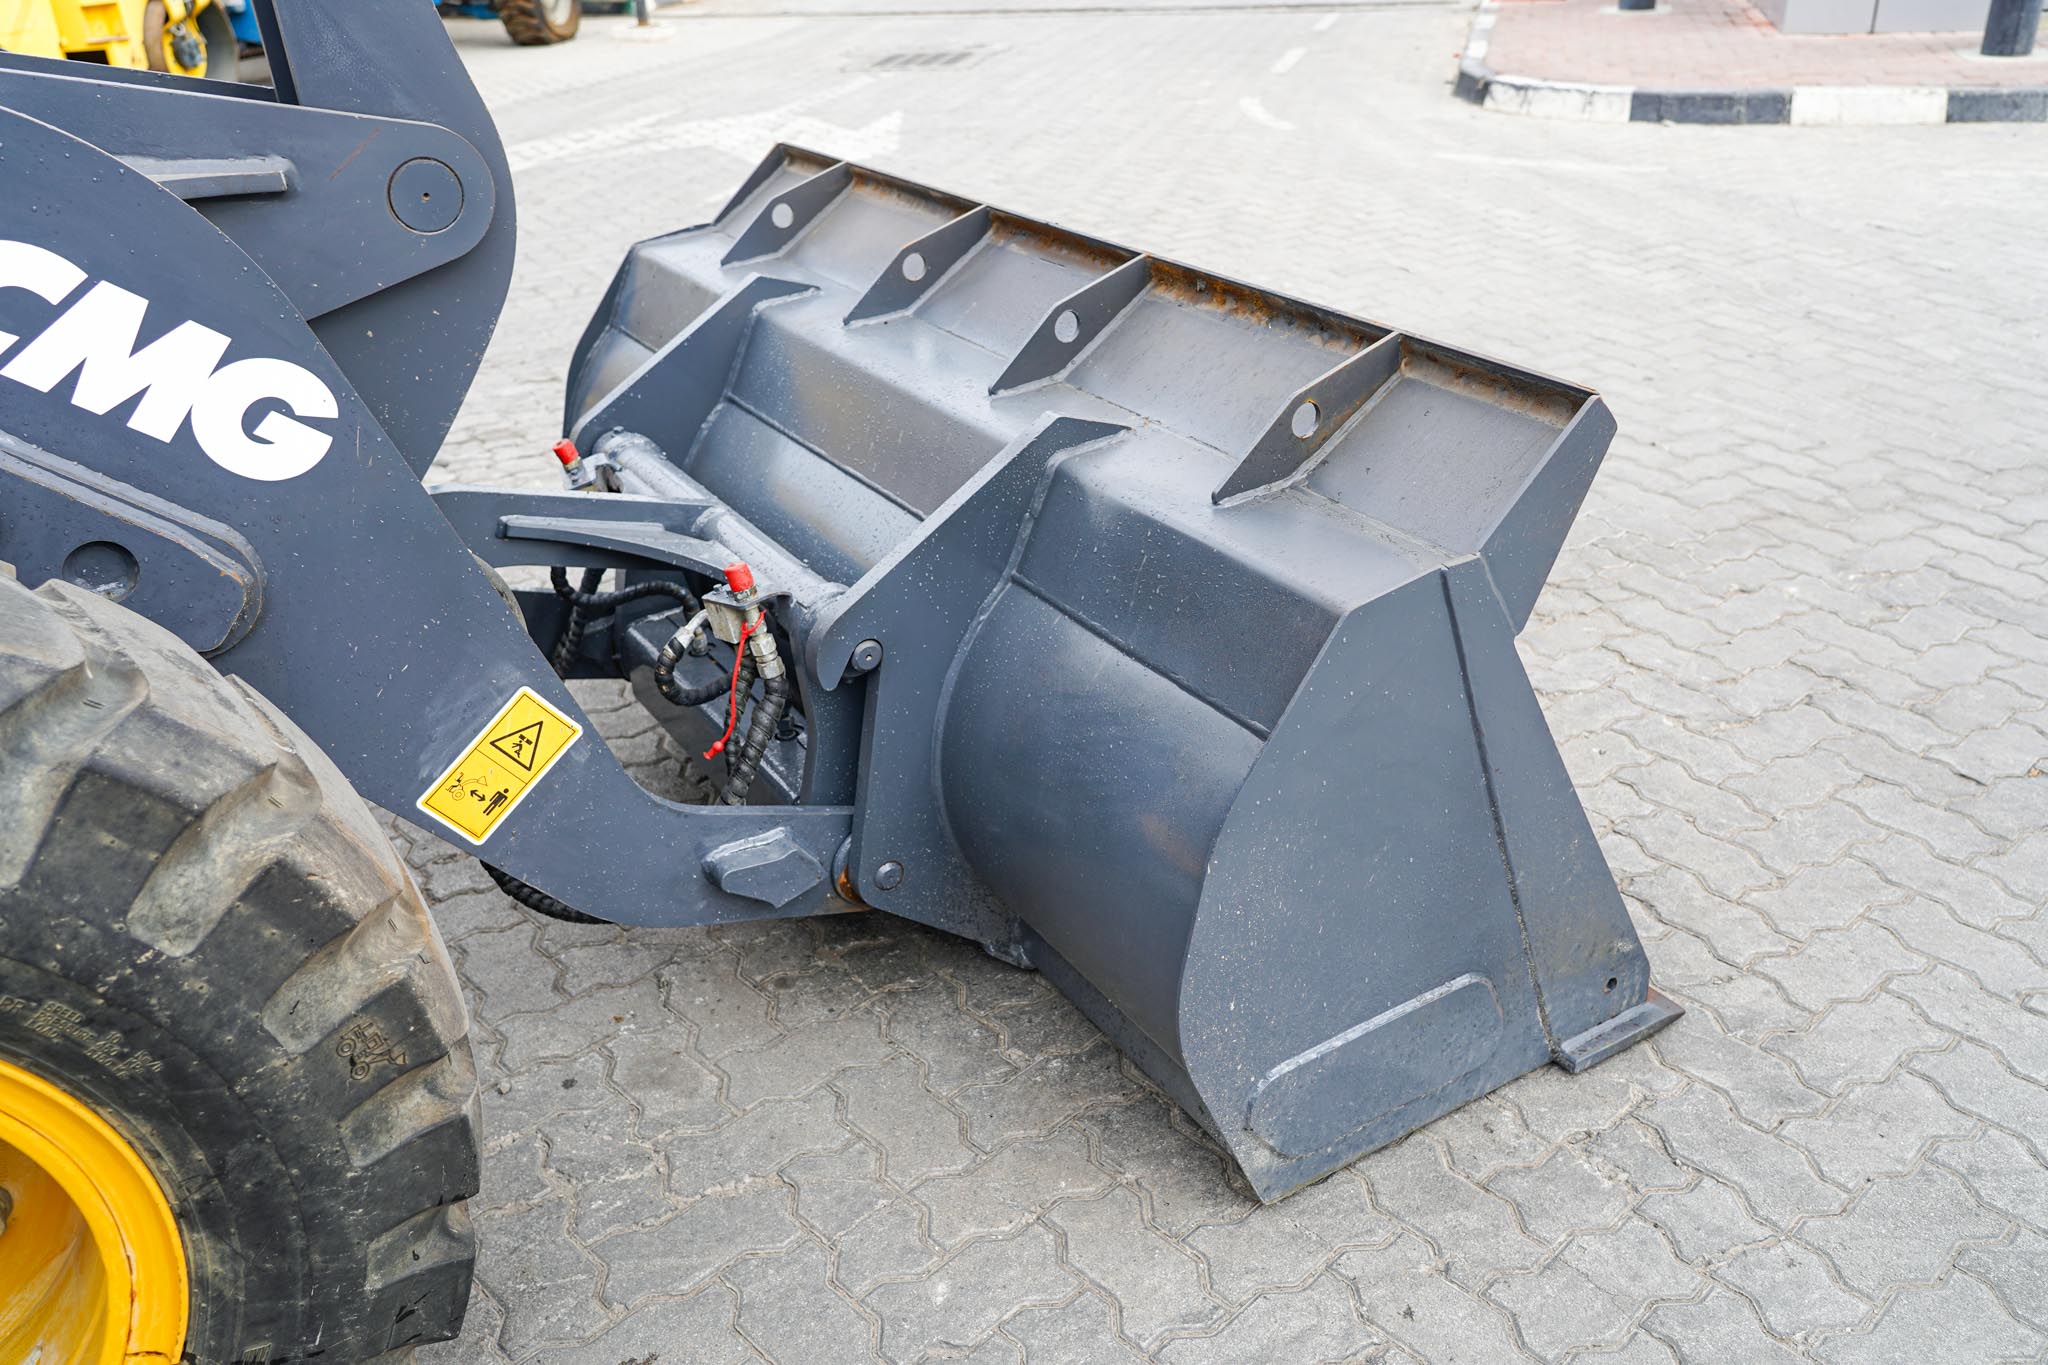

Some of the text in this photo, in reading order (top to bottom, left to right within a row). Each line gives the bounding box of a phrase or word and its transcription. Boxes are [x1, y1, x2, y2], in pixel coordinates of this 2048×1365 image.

[43, 1001, 86, 1023] SPEED
[24, 1018, 60, 1038] LOAD
[33, 1010, 98, 1041] PRESSURE
